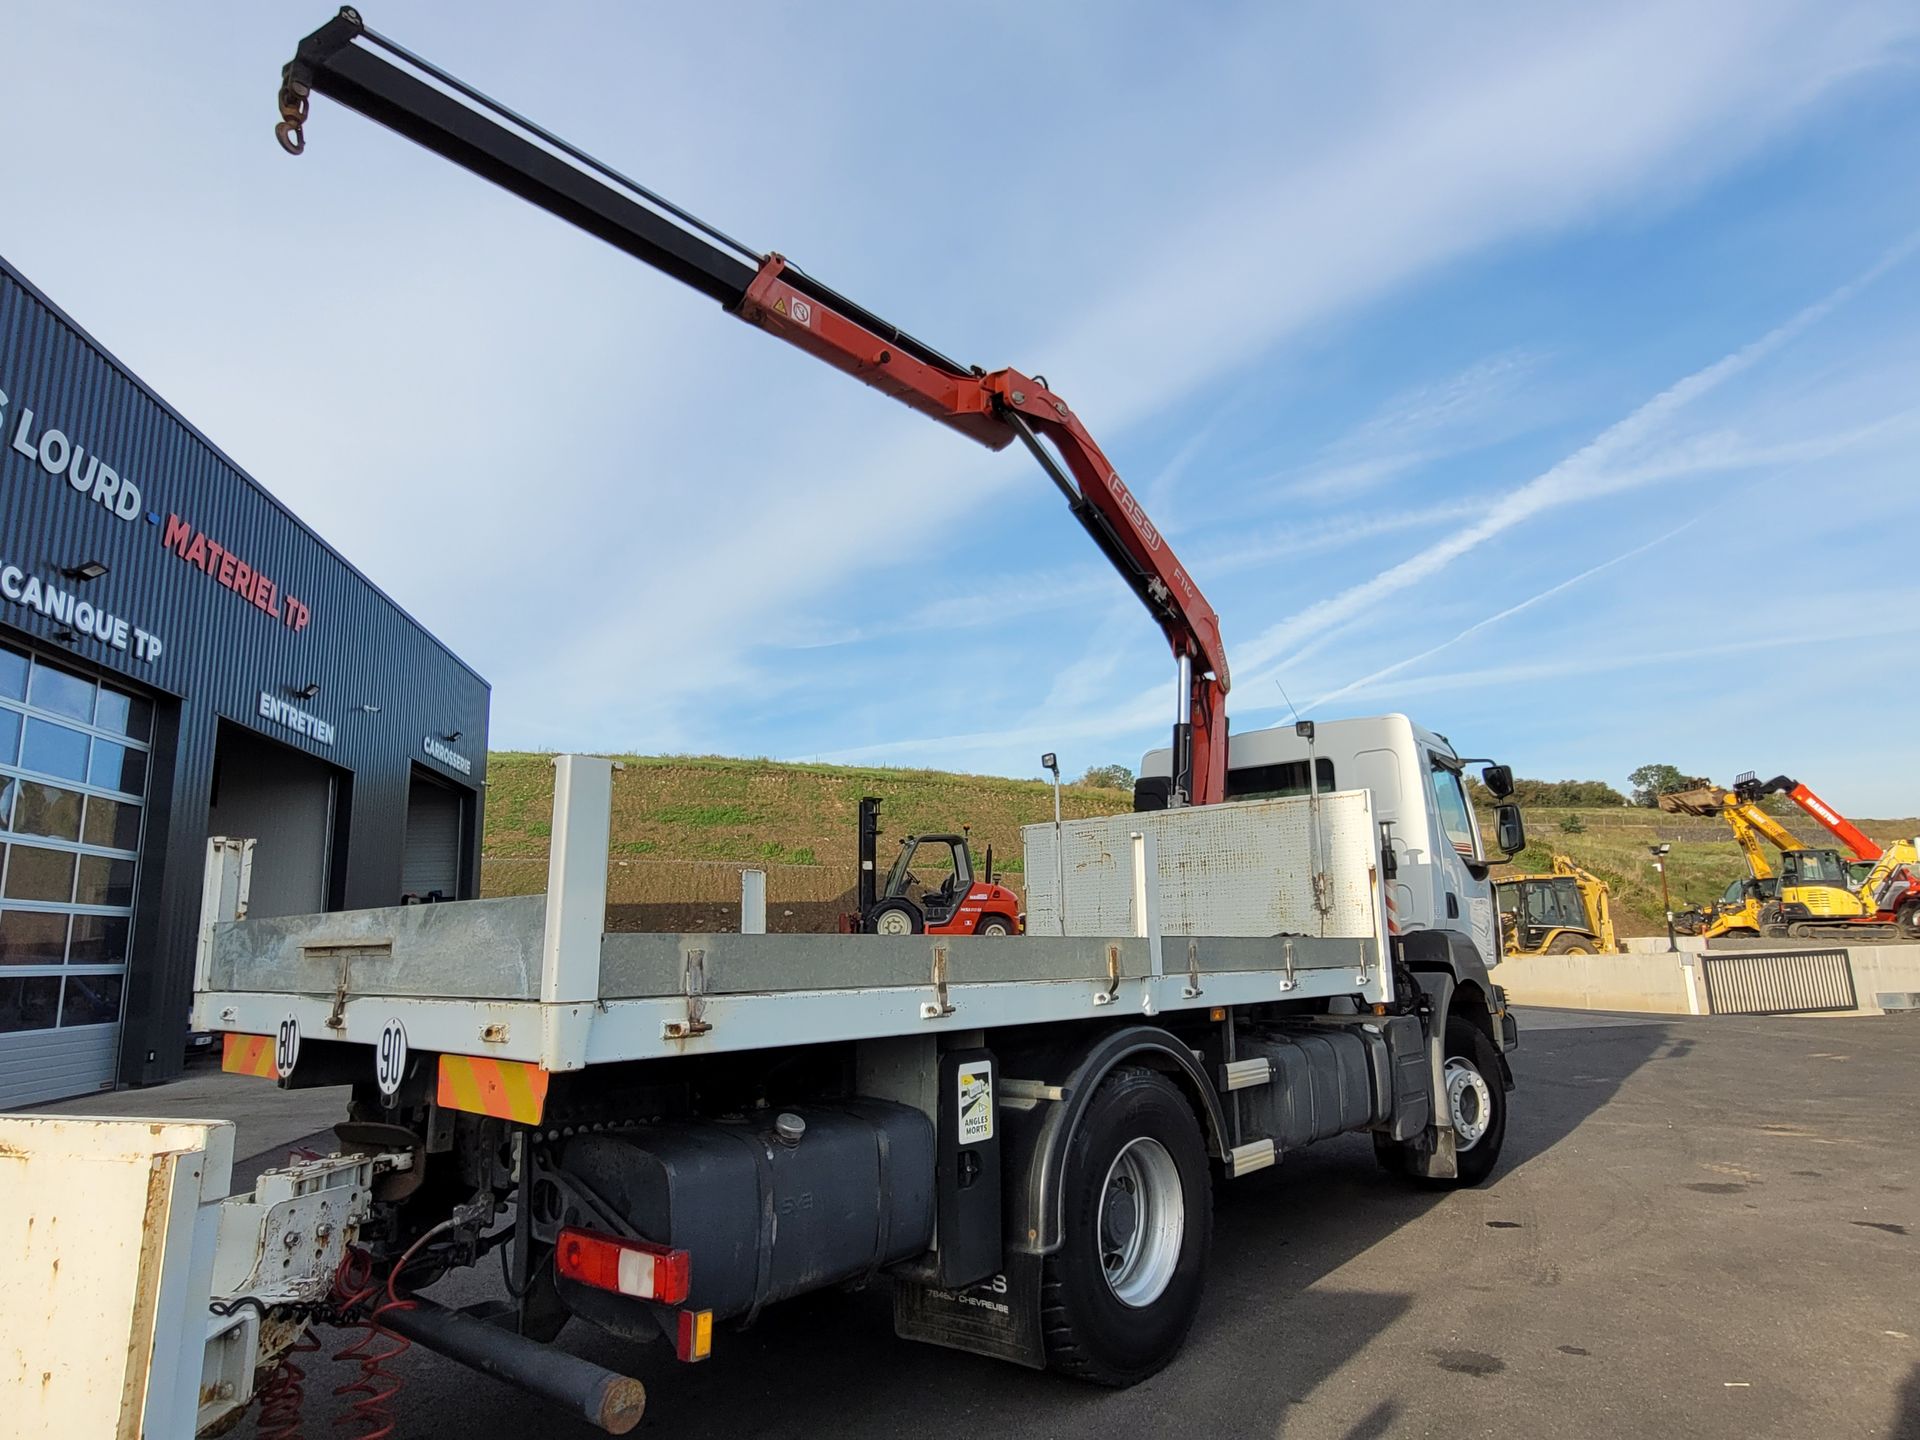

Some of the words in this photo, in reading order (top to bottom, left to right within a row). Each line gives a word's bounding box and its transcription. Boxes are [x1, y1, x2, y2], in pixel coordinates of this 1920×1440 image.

[12, 407, 142, 522] LOURD
[163, 512, 279, 618] MATERIEL
[286, 594, 309, 632] TP
[1112, 477, 1158, 545] FASSI
[0, 560, 129, 650] CANIQUE
[133, 627, 163, 662] TP
[260, 691, 334, 746] ENTRETIEN
[423, 736, 471, 776] CARROSSERIE
[278, 1019, 297, 1070] 80
[380, 1026, 402, 1084] 90
[964, 1115, 989, 1127] ANGLES
[966, 1123, 988, 1135] MORTS
